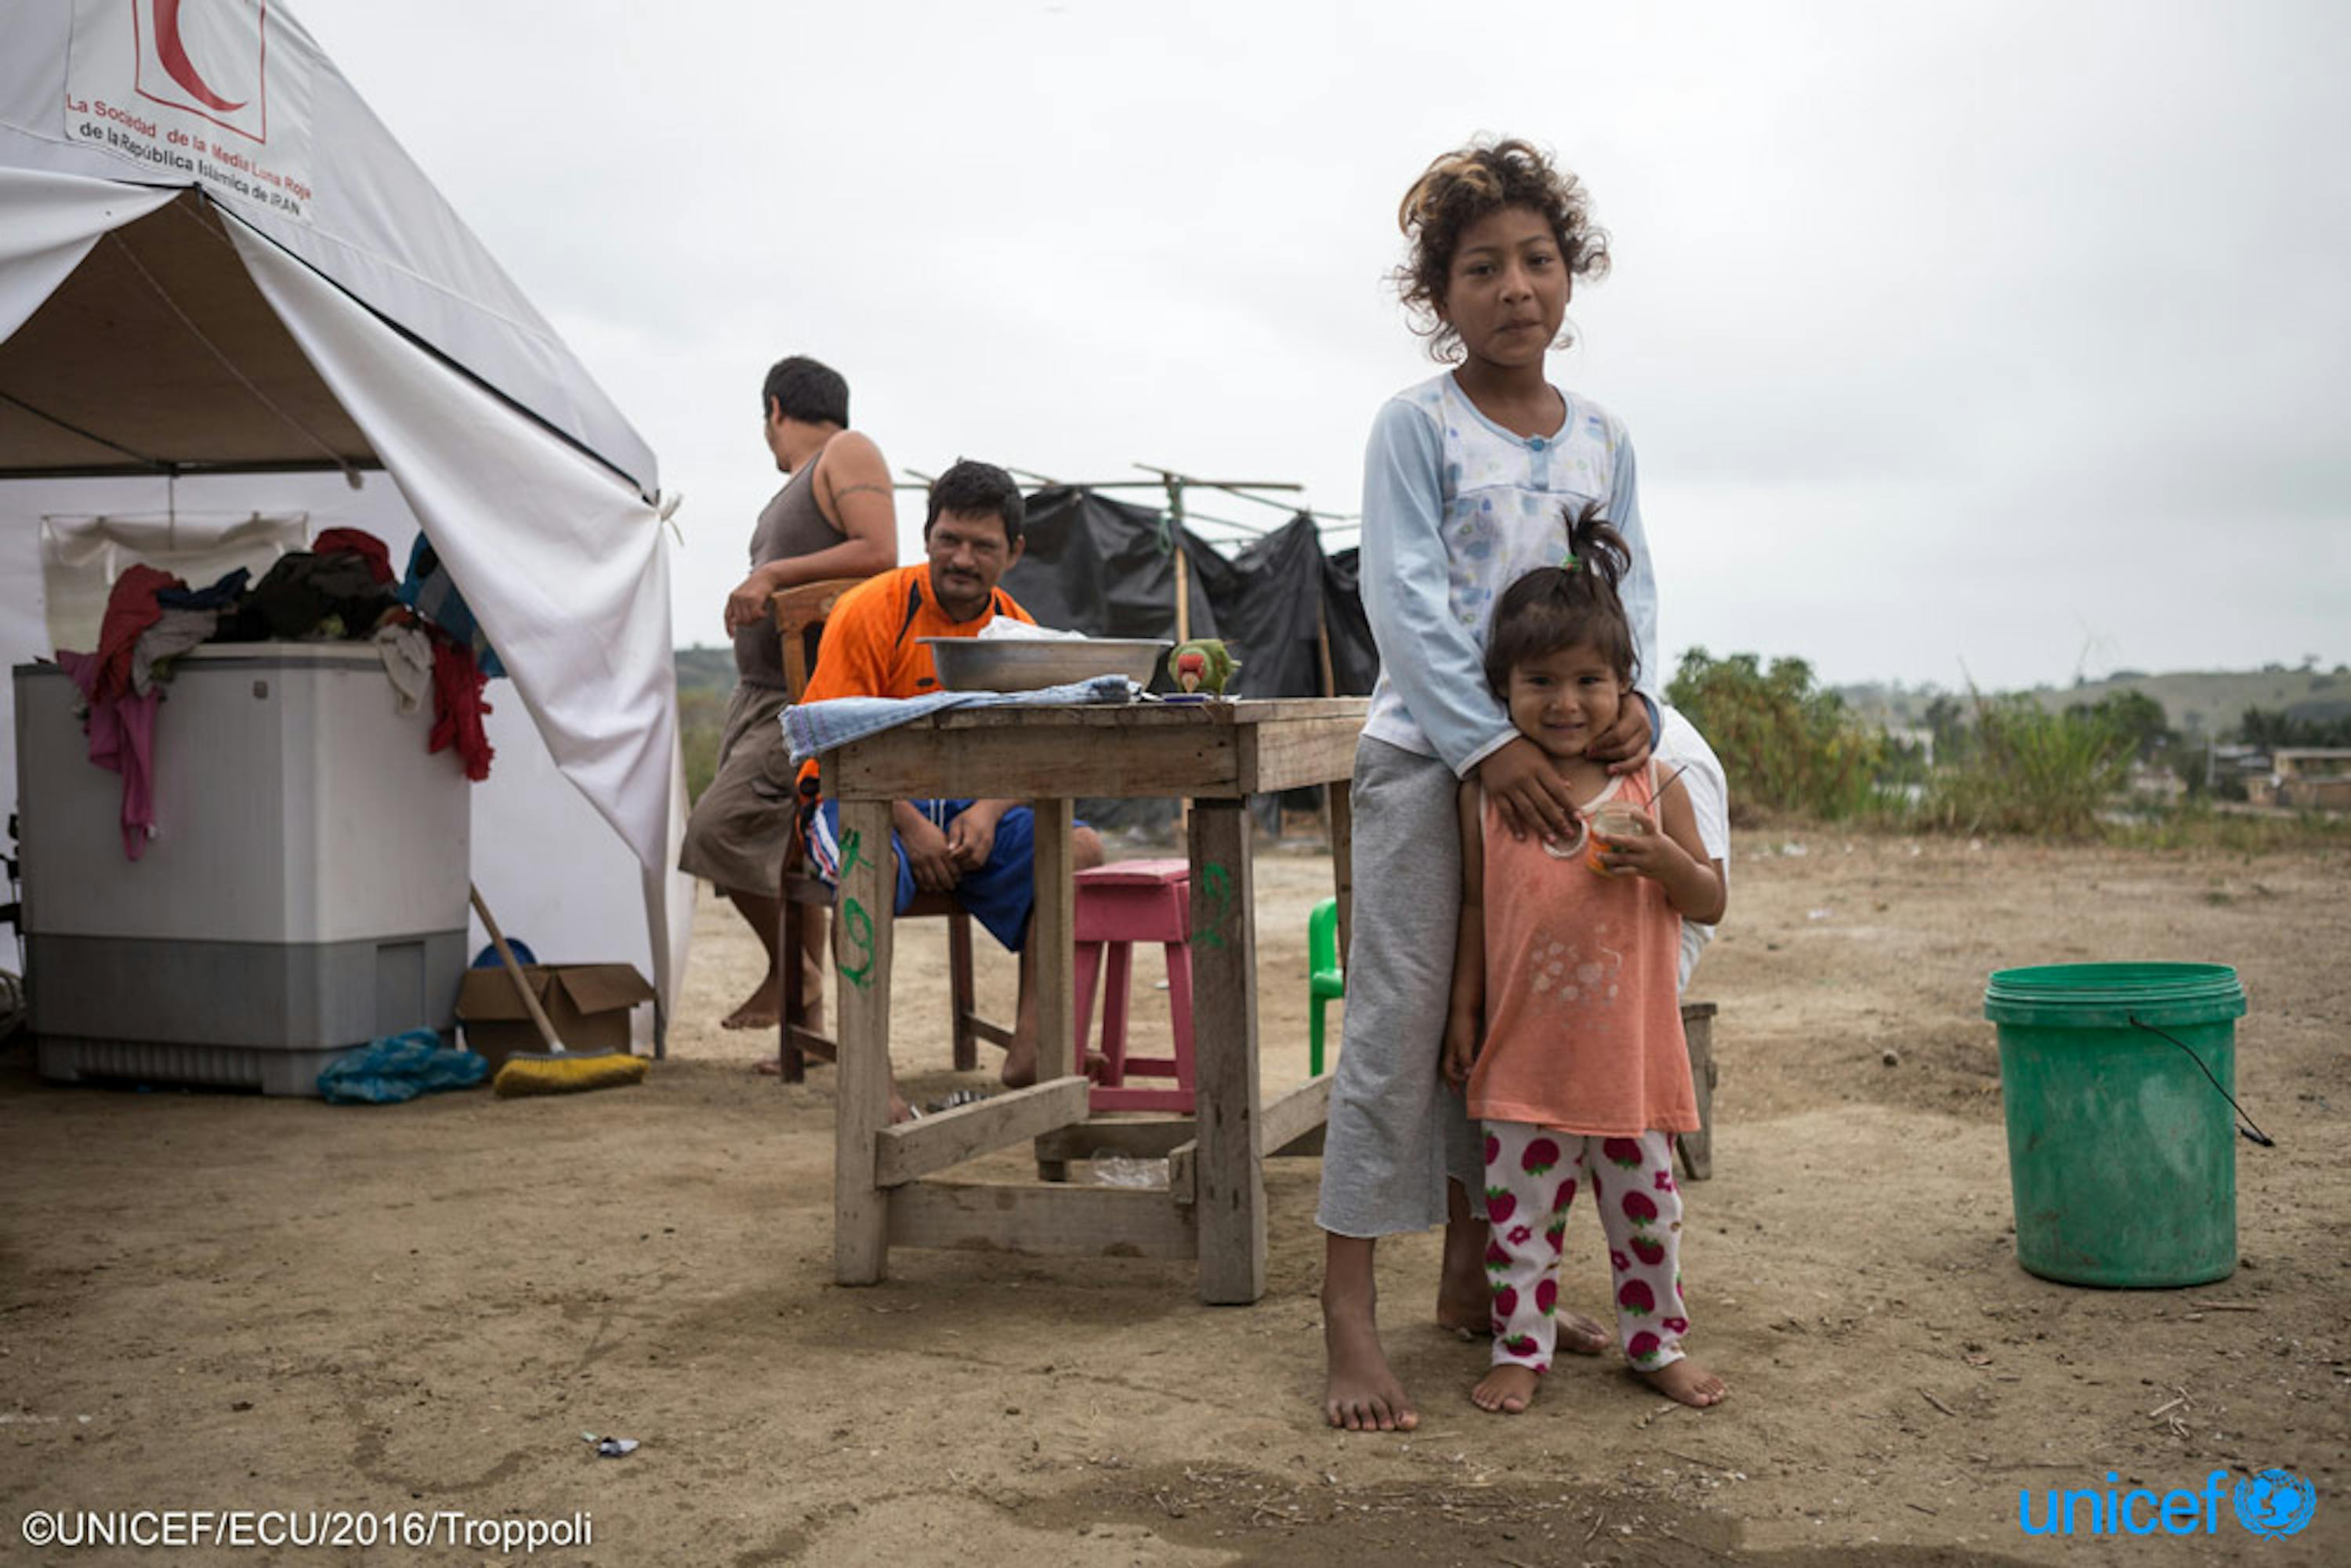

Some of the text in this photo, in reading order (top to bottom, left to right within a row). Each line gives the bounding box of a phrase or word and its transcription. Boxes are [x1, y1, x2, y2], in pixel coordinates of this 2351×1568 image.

[67, 92, 88, 113] La
[166, 128, 189, 147] de
[193, 135, 206, 152] la
[251, 160, 281, 186] Luna
[284, 175, 312, 201] Roja
[79, 121, 103, 139] de
[107, 126, 118, 147] la
[252, 185, 268, 203] de
